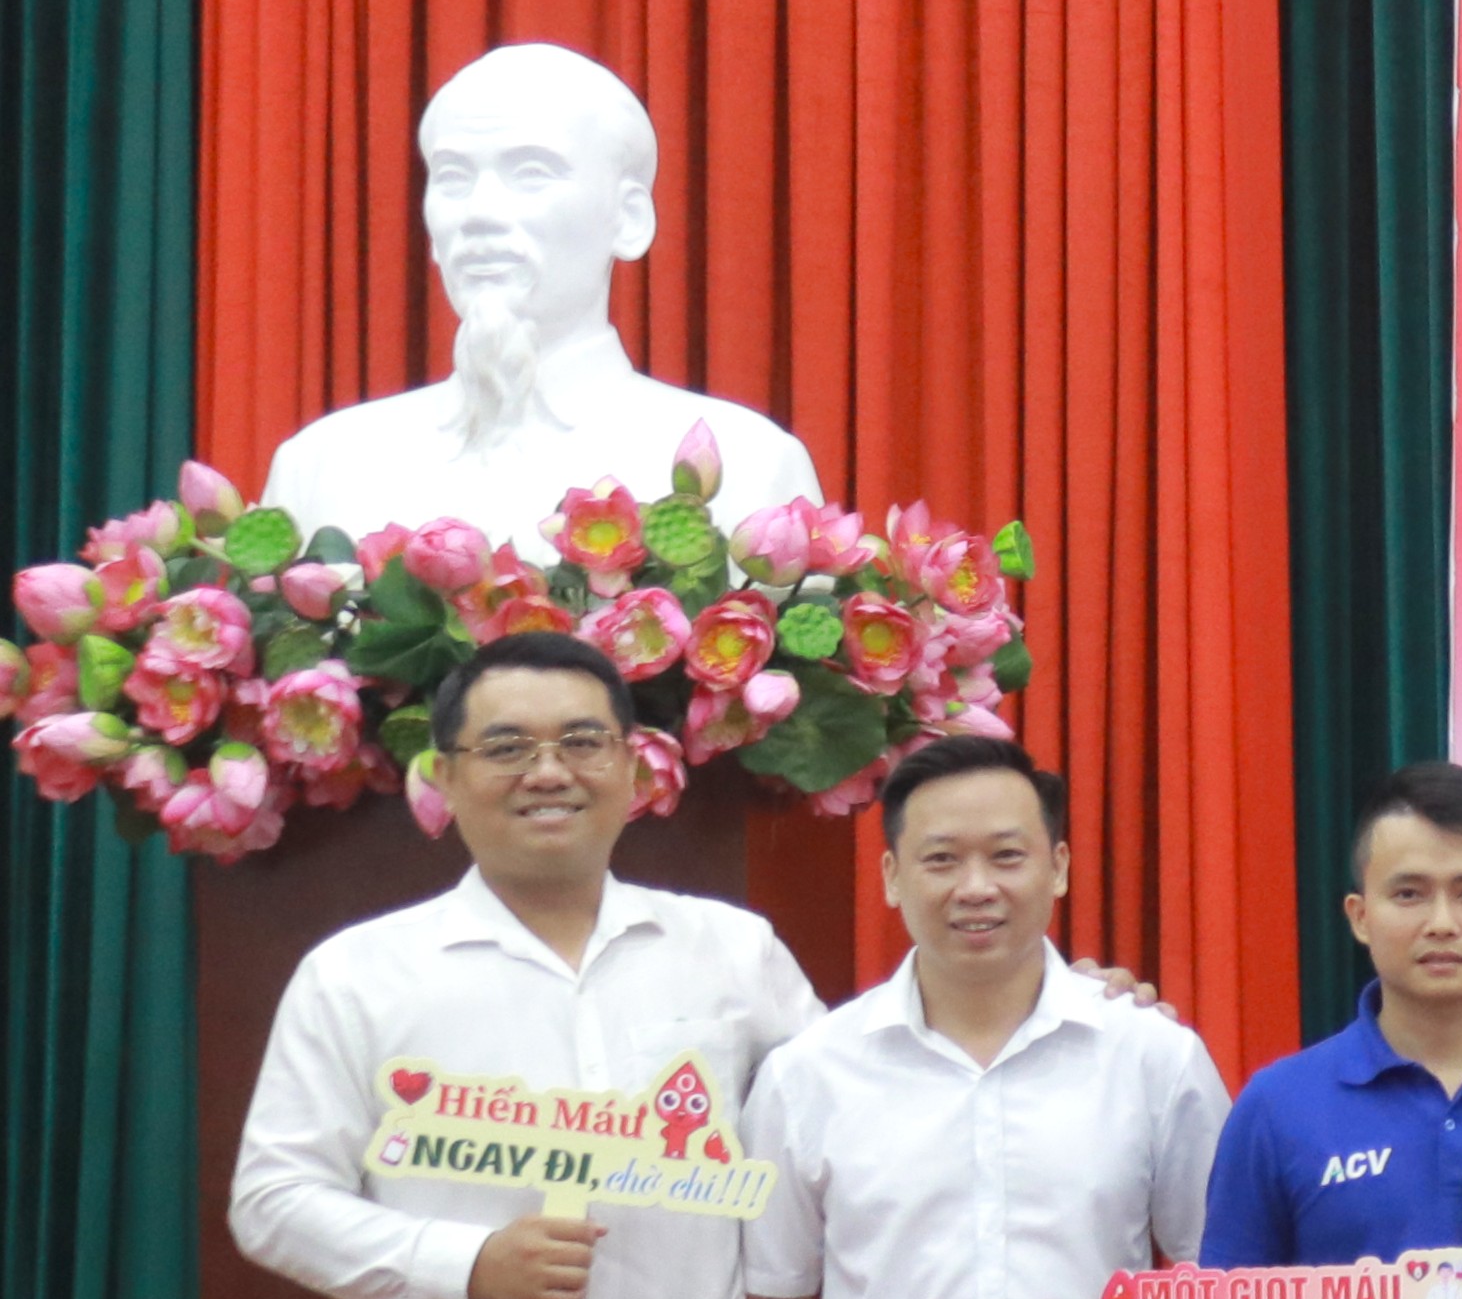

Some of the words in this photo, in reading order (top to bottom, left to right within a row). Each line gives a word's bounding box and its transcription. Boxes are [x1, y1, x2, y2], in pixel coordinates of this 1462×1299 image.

[434, 1083, 538, 1128] Hiến
[411, 1134, 536, 1177] NGAY
[544, 1148, 599, 1192] ĐI,
[1320, 1148, 1392, 1187] ACV
